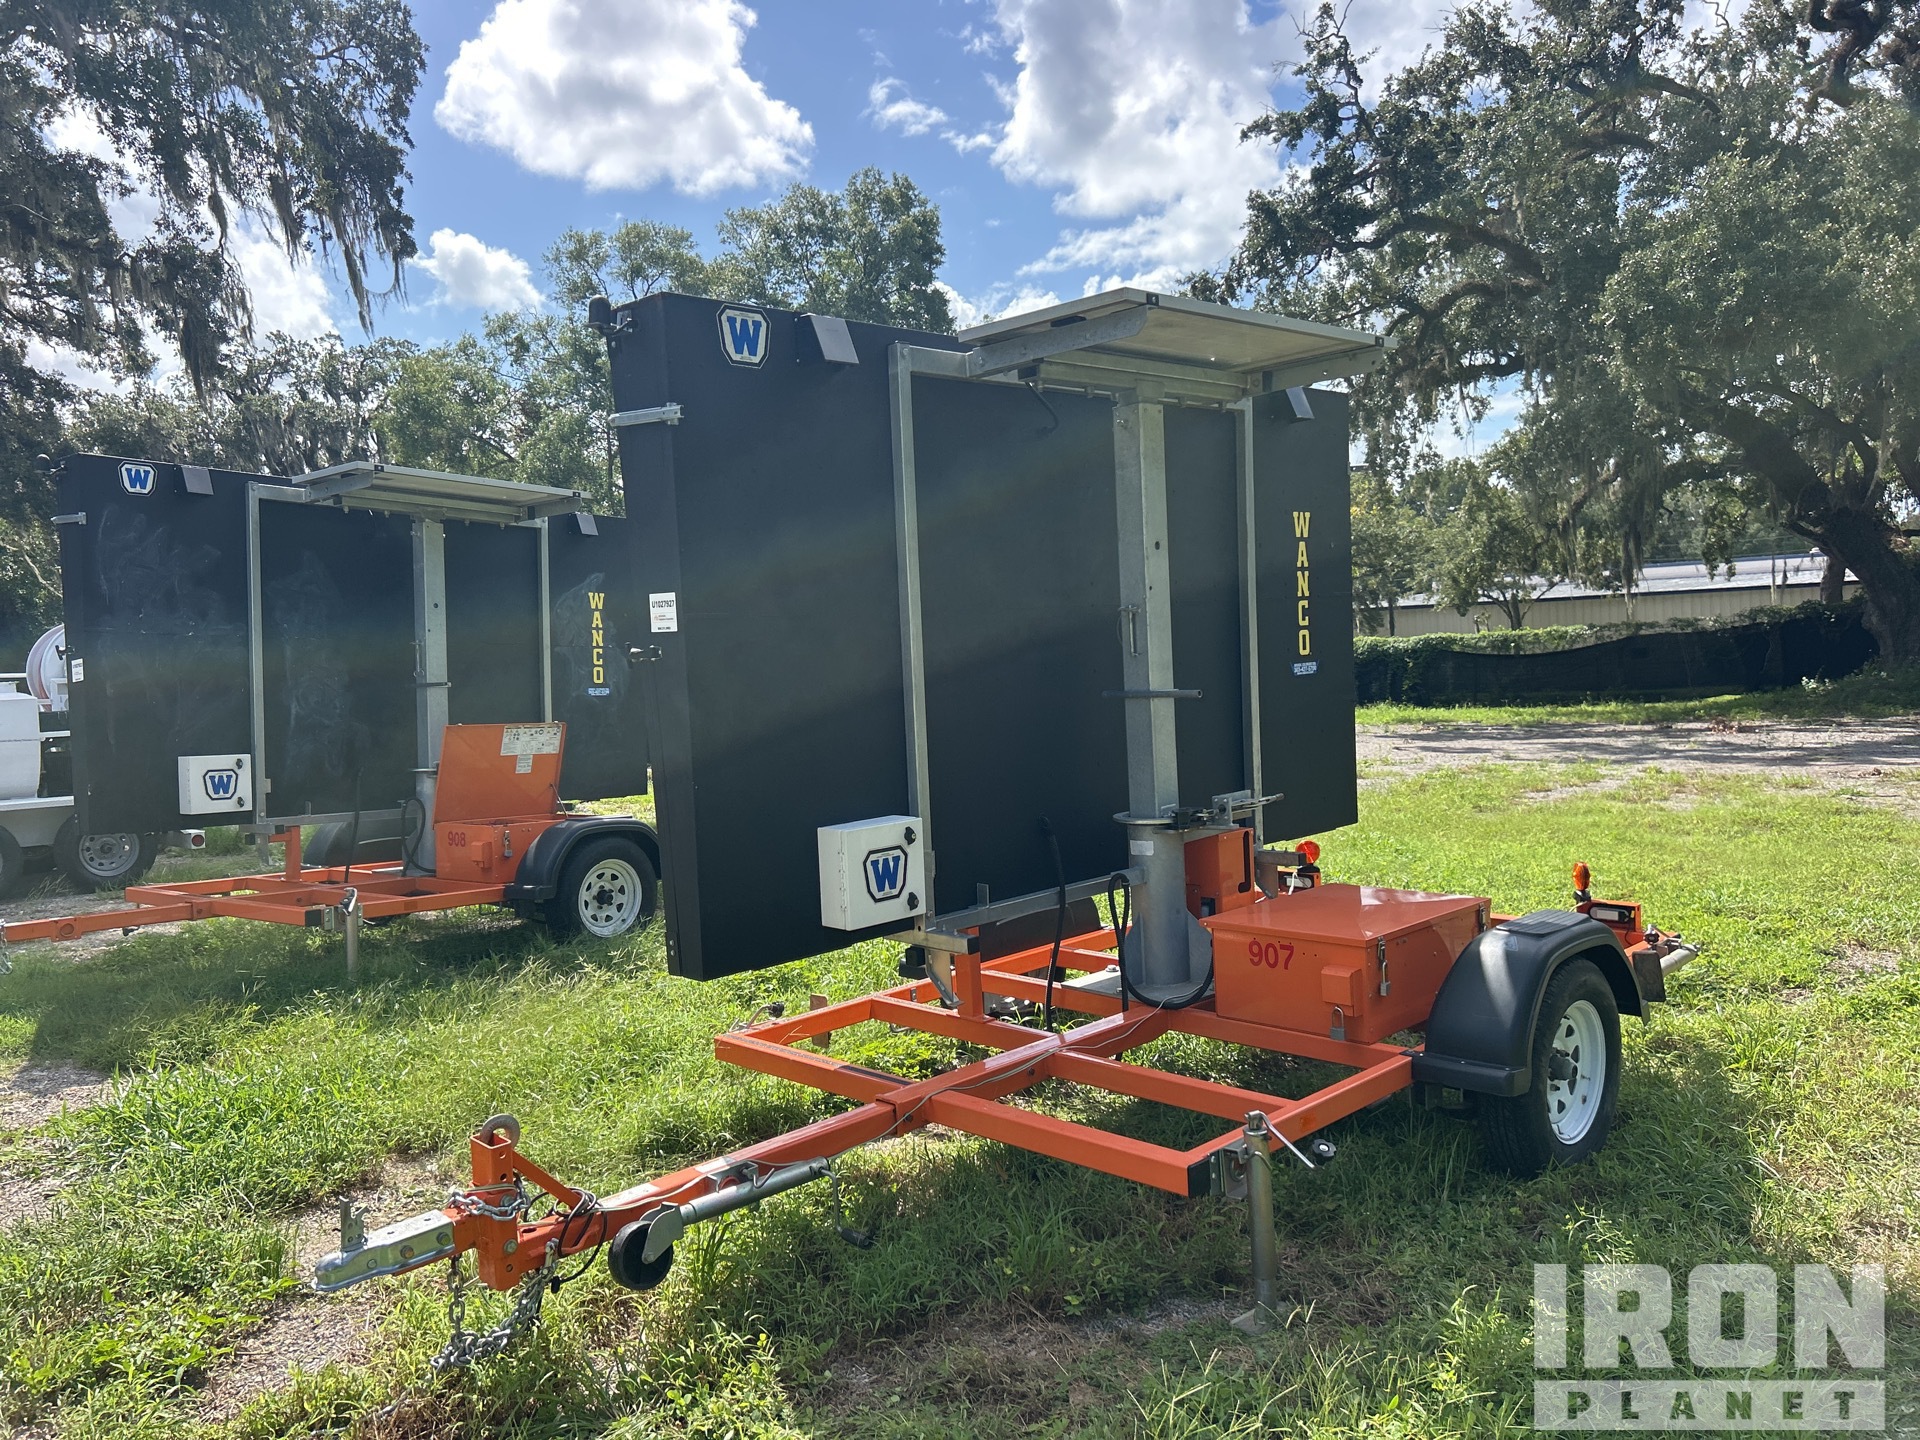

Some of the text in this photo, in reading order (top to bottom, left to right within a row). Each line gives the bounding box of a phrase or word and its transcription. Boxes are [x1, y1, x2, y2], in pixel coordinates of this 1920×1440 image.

[727, 316, 762, 356] W
[125, 468, 150, 489] W
[1293, 512, 1310, 655] WANCO
[588, 592, 604, 683] WANCO
[209, 775, 232, 794] W
[448, 831, 465, 847] 908
[871, 855, 900, 892] W
[1249, 940, 1294, 970] 907
